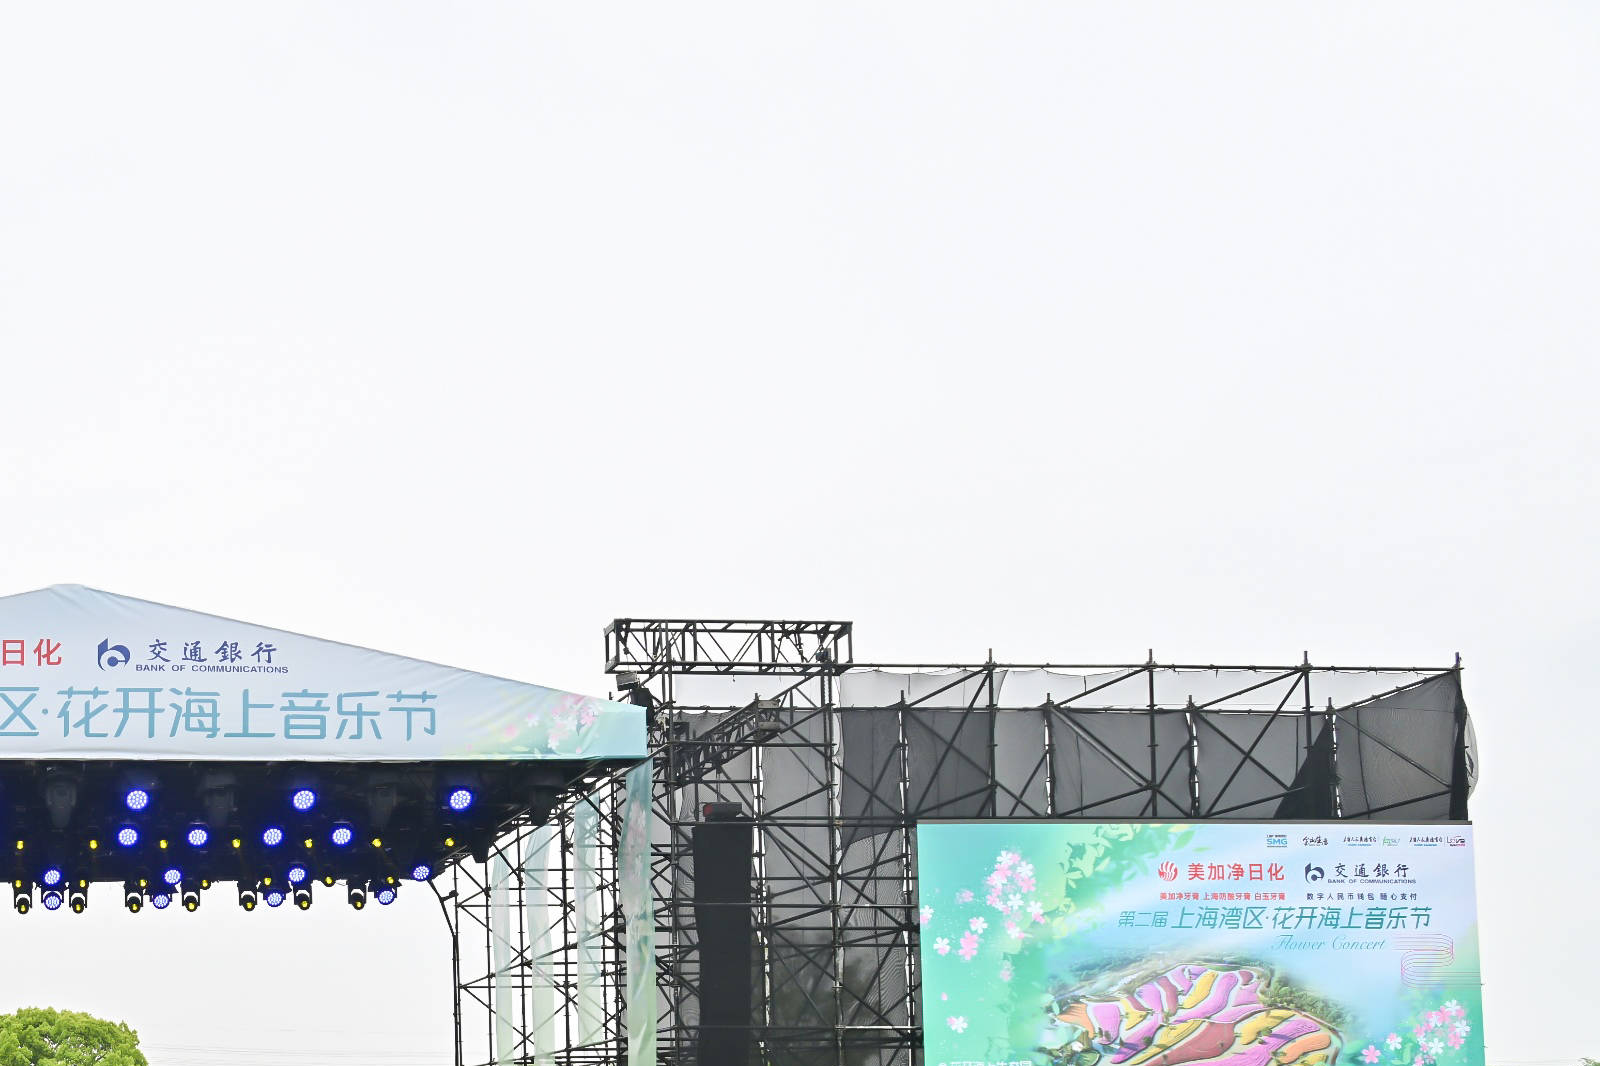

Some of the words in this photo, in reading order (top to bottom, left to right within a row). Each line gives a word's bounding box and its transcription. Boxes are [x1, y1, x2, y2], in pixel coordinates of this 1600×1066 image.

[148, 638, 277, 663] 交通銀行
[136, 664, 166, 672] BANK
[172, 664, 188, 672] OF
[191, 665, 289, 674] COMMUNICATIONS
[1188, 862, 1285, 881] 美加净日化
[1334, 863, 1410, 878] 交通銀行
[1270, 934, 1326, 950] Flower
[1332, 934, 1387, 950] Concert
